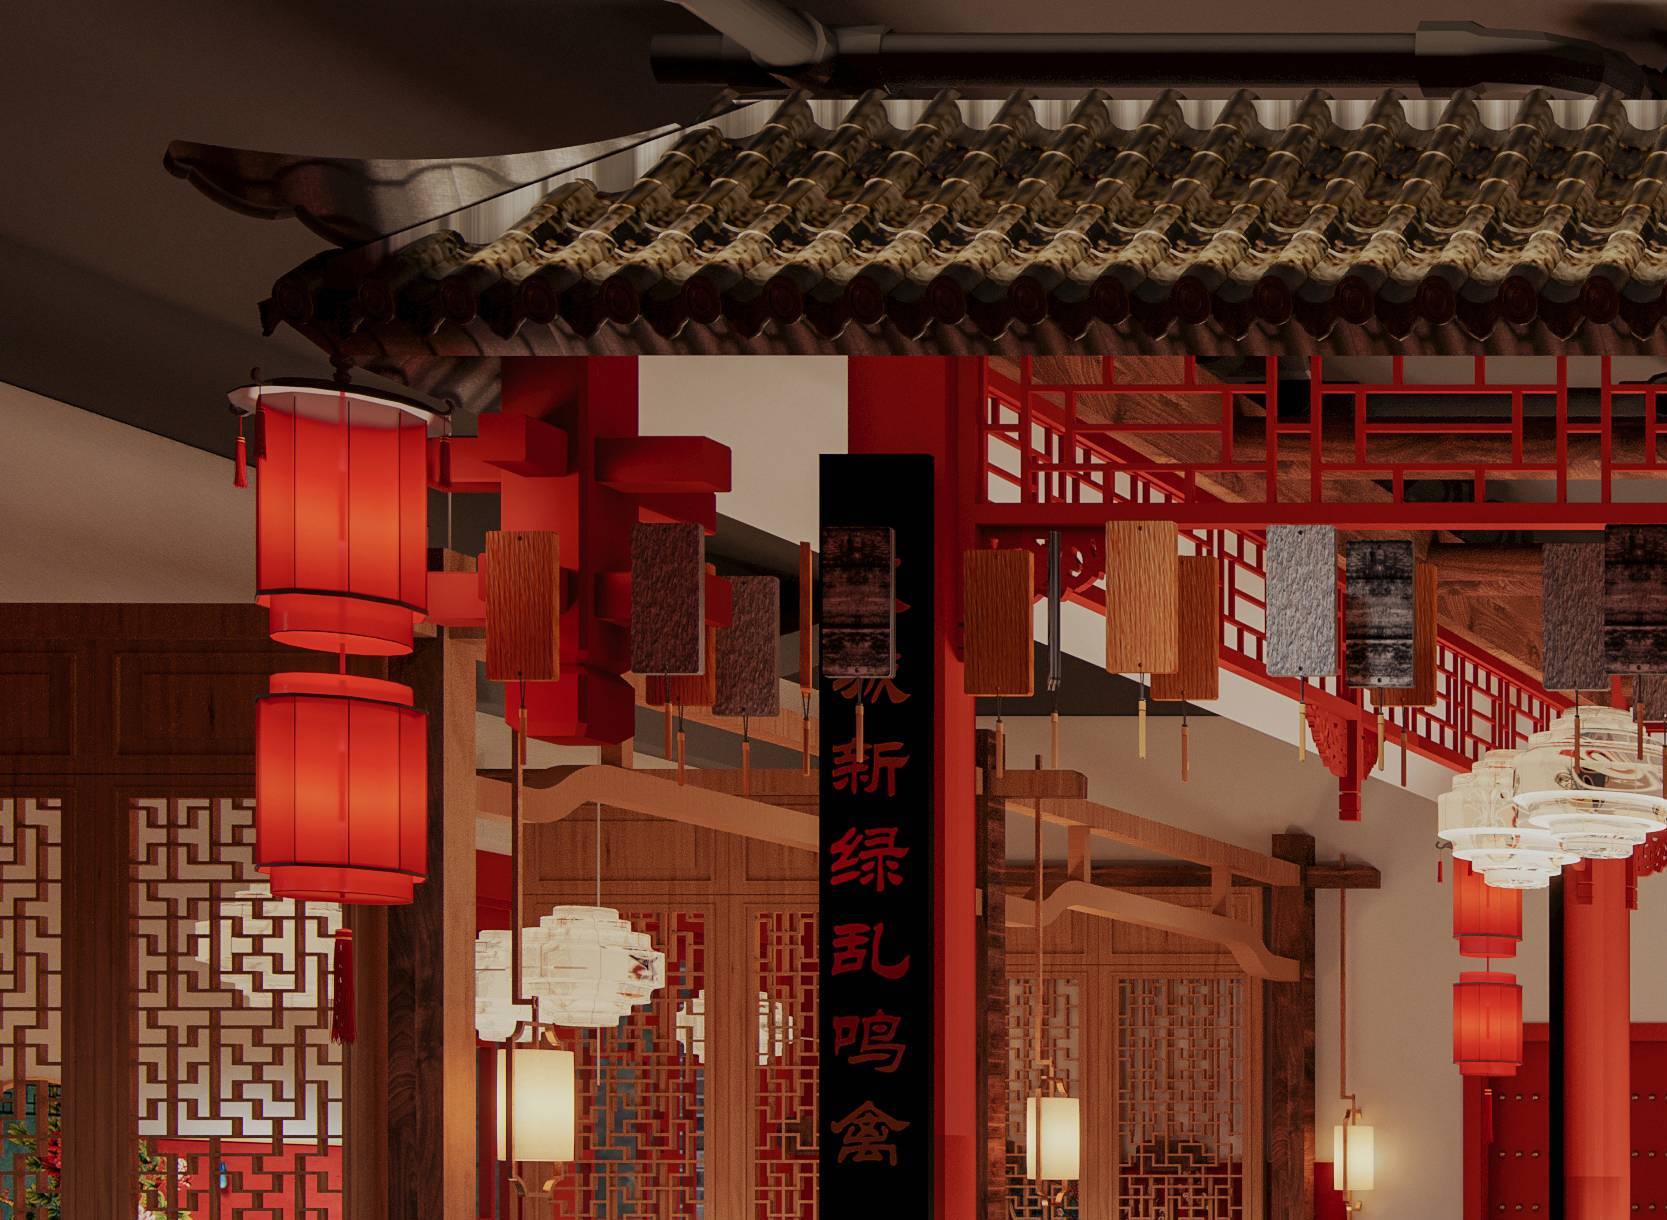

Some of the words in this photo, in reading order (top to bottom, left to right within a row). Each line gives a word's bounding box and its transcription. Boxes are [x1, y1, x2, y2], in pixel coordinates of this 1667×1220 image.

[829, 556, 912, 1167] 新绿乱鸣禽
